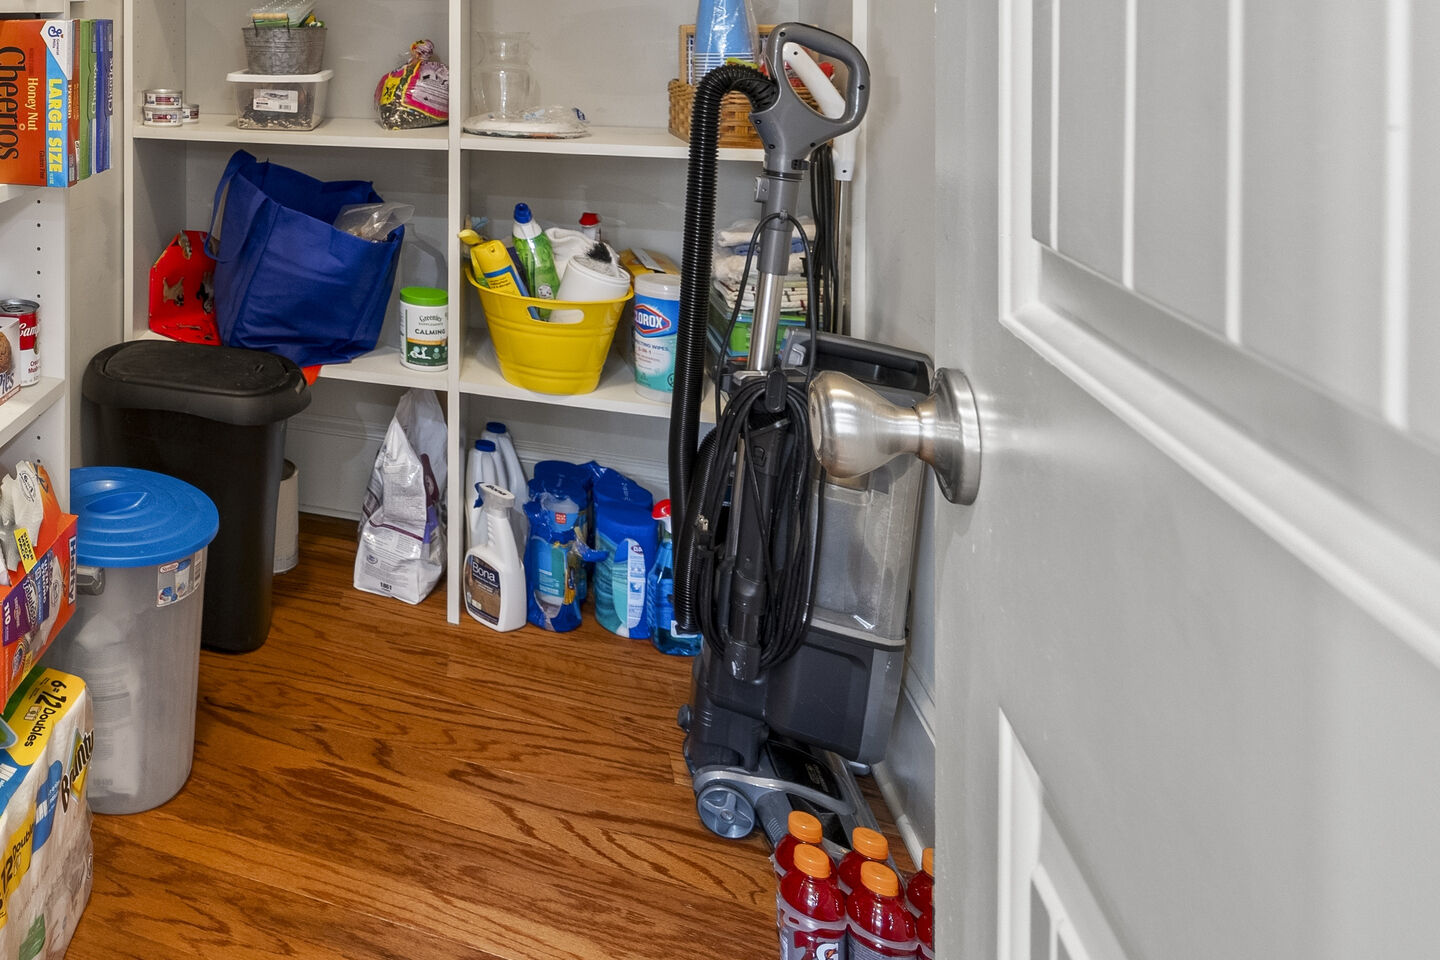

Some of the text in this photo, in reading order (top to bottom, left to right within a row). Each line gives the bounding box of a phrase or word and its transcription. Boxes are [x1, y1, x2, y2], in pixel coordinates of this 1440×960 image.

[25, 77, 39, 131] Honey Nut
[48, 78, 63, 173] LARGE SIZE
[414, 327, 447, 336] CALMING
[634, 311, 663, 329] LOROX
[471, 560, 496, 583] Bona
[24, 707, 56, 748] Doubles
